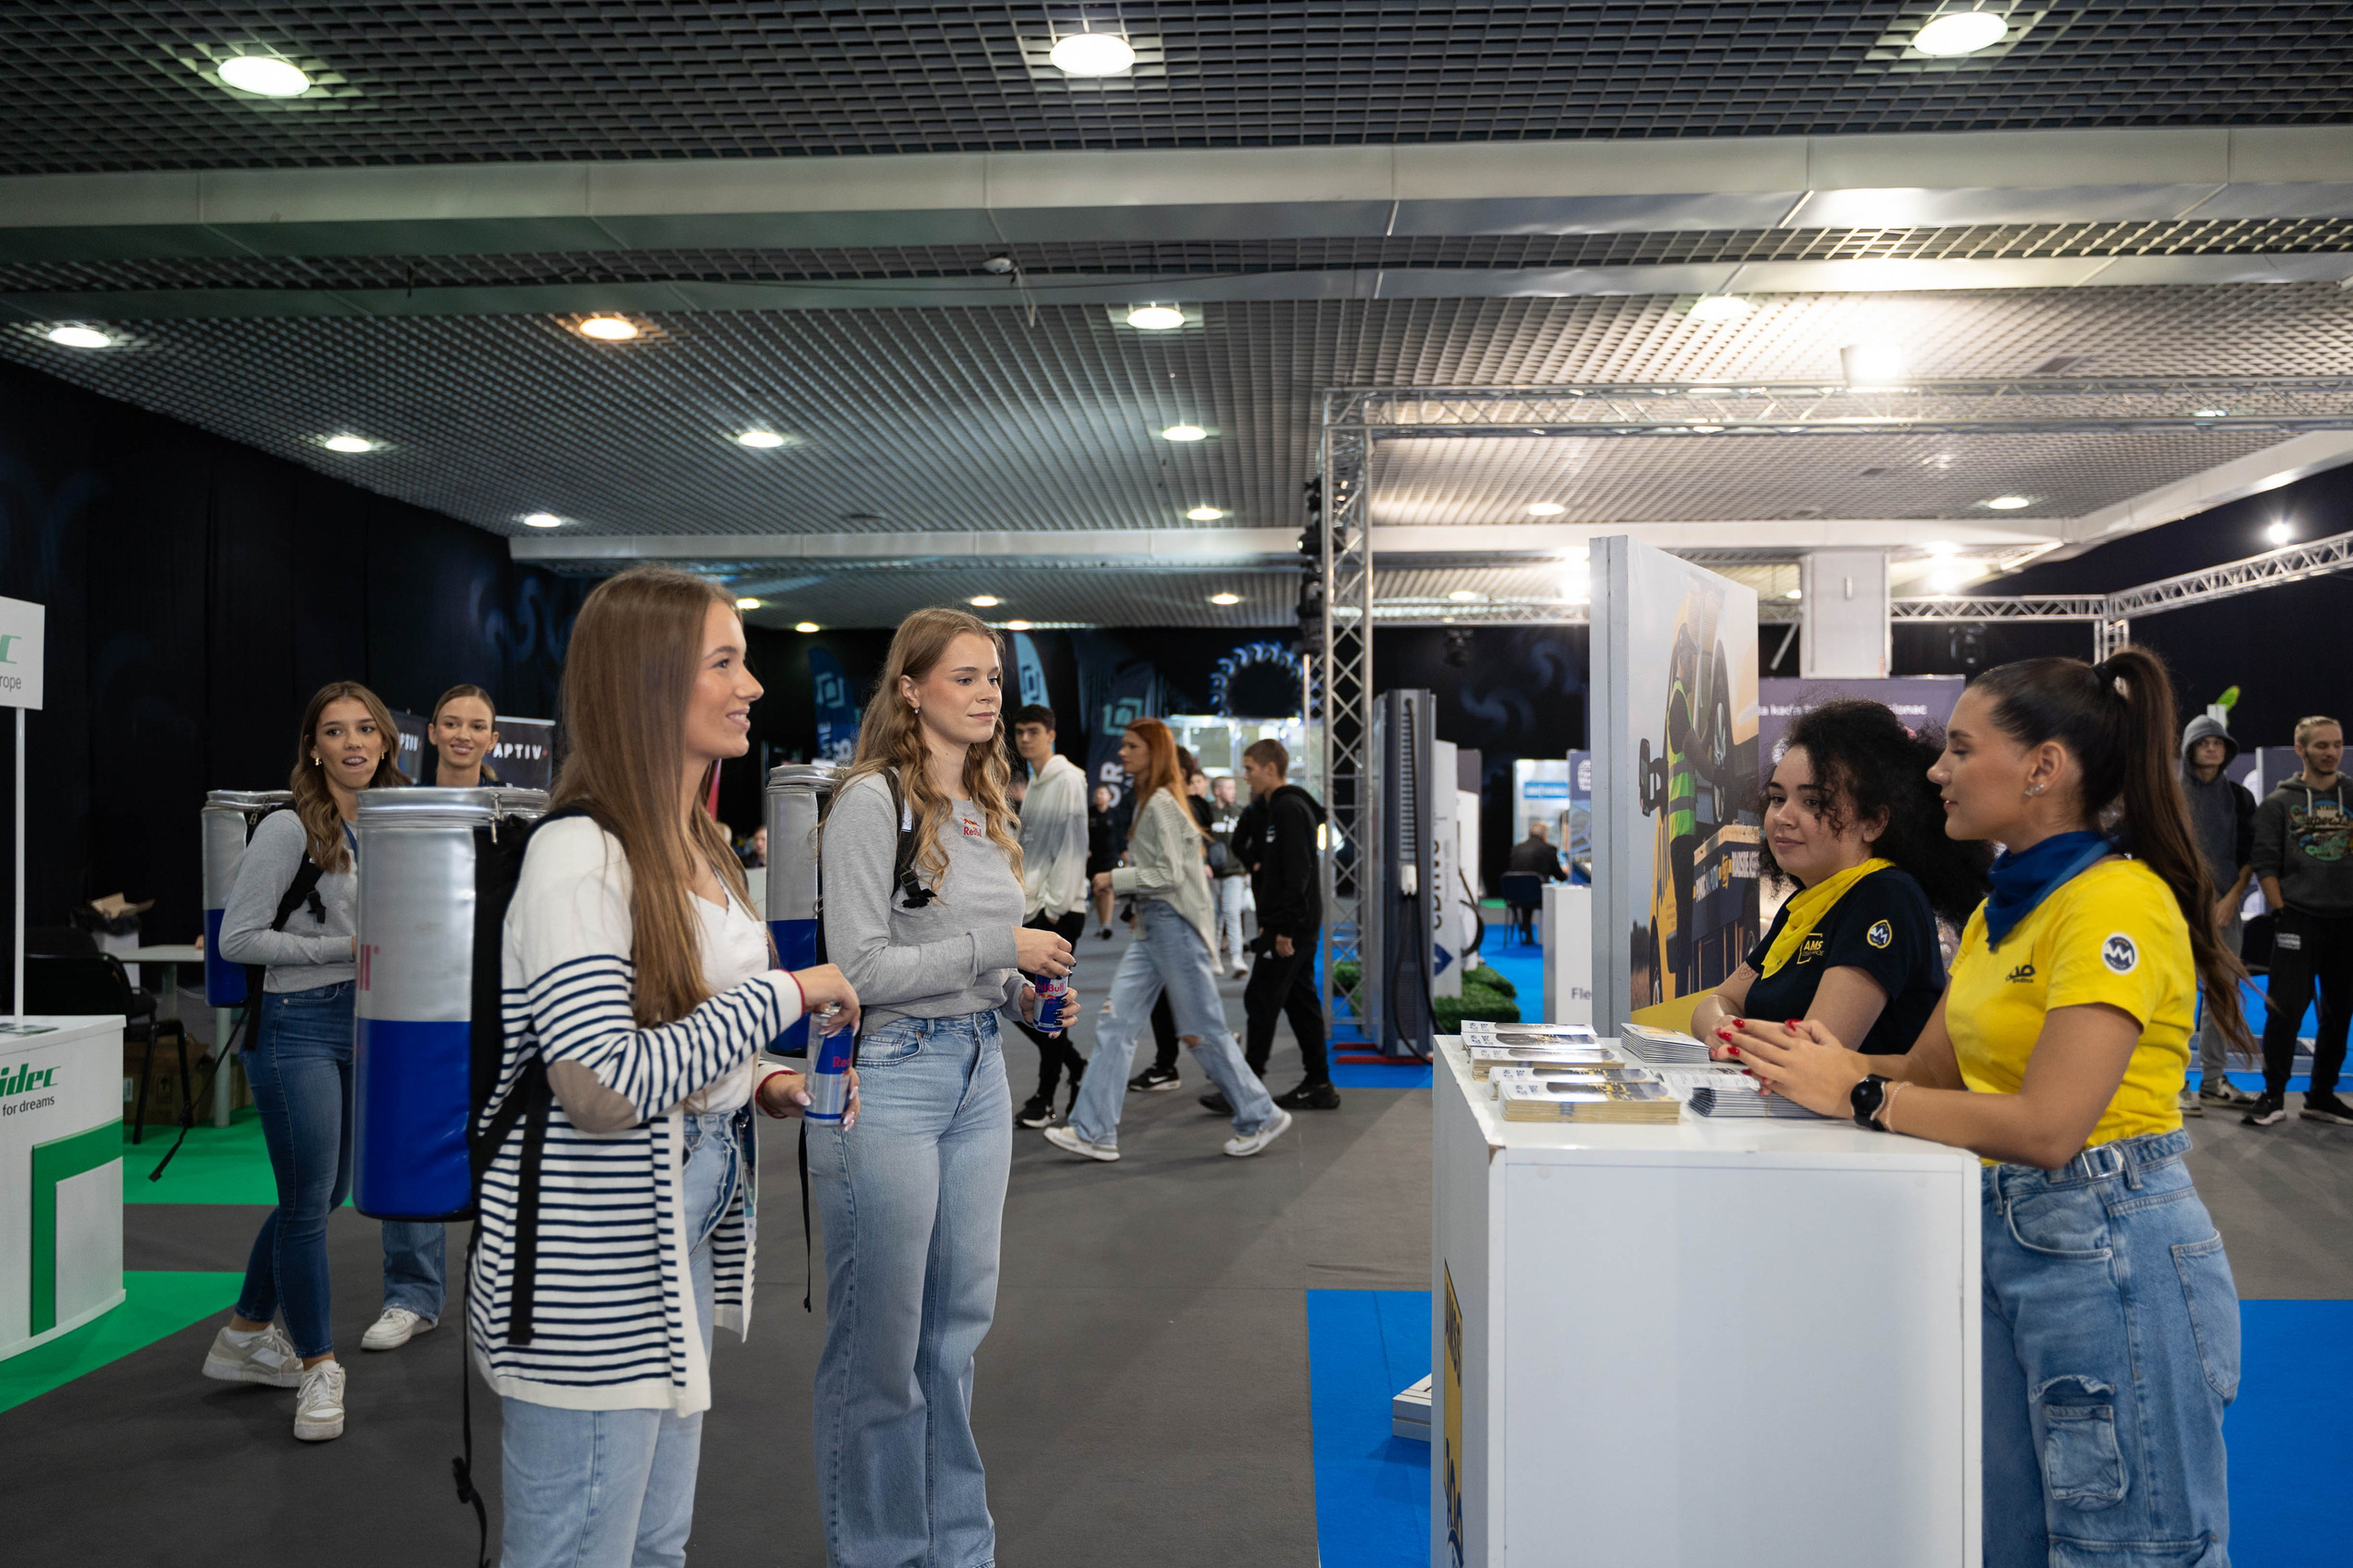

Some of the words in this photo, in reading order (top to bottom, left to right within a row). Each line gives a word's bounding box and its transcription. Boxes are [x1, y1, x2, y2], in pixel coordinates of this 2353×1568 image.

[0, 676, 22, 692] rope
[399, 733, 419, 752] PTIV
[494, 743, 542, 760] APTIV
[1803, 940, 1824, 951] AMS
[1048, 983, 1064, 993] Bull
[1572, 987, 1591, 1000] Fle
[0, 1062, 61, 1097] idec
[3, 1104, 17, 1117] for
[19, 1096, 55, 1113] dreams
